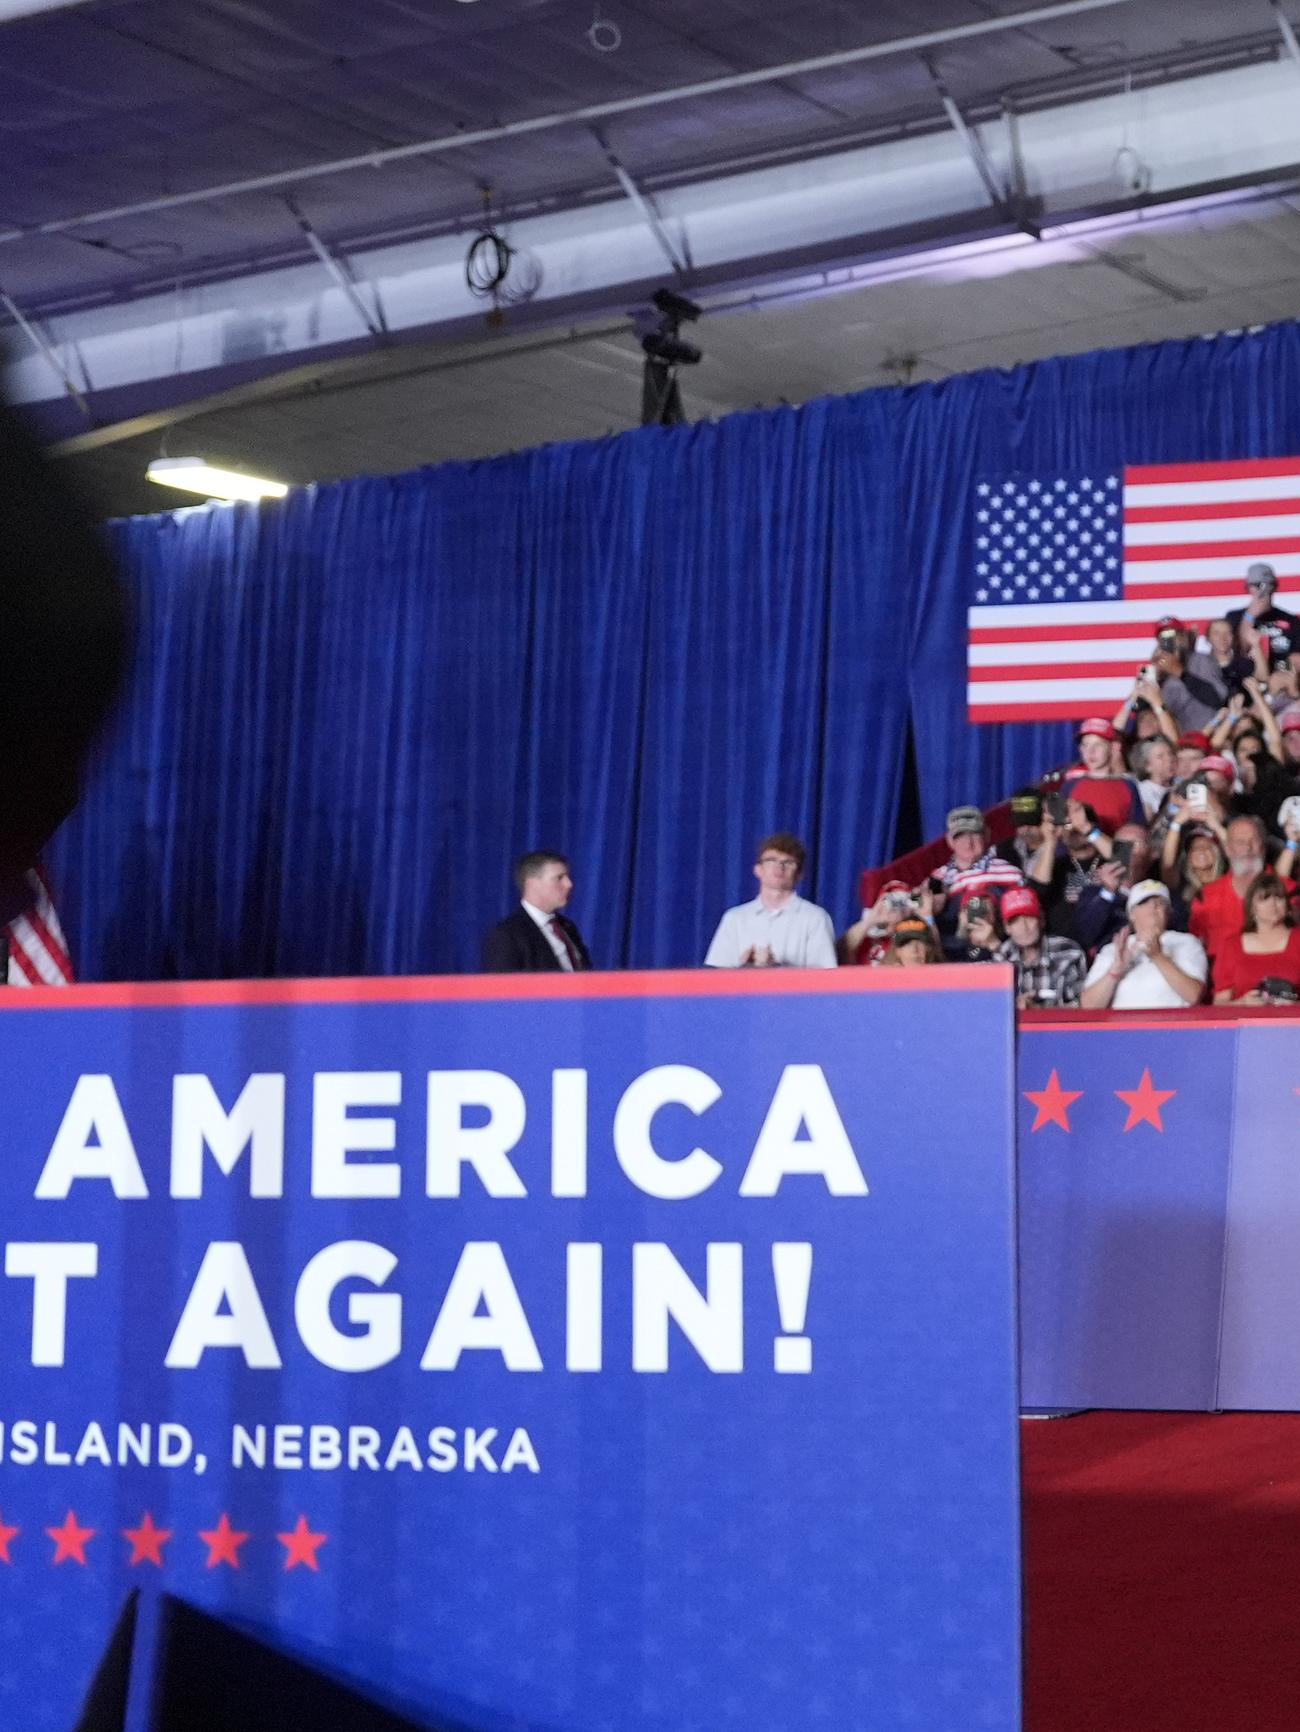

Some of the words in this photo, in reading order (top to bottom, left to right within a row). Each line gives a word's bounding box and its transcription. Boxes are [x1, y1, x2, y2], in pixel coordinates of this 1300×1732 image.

[34, 1063, 870, 1200] AMERICA
[164, 1240, 813, 1374] AGAIN!
[232, 1424, 541, 1473] NEBRASKA
